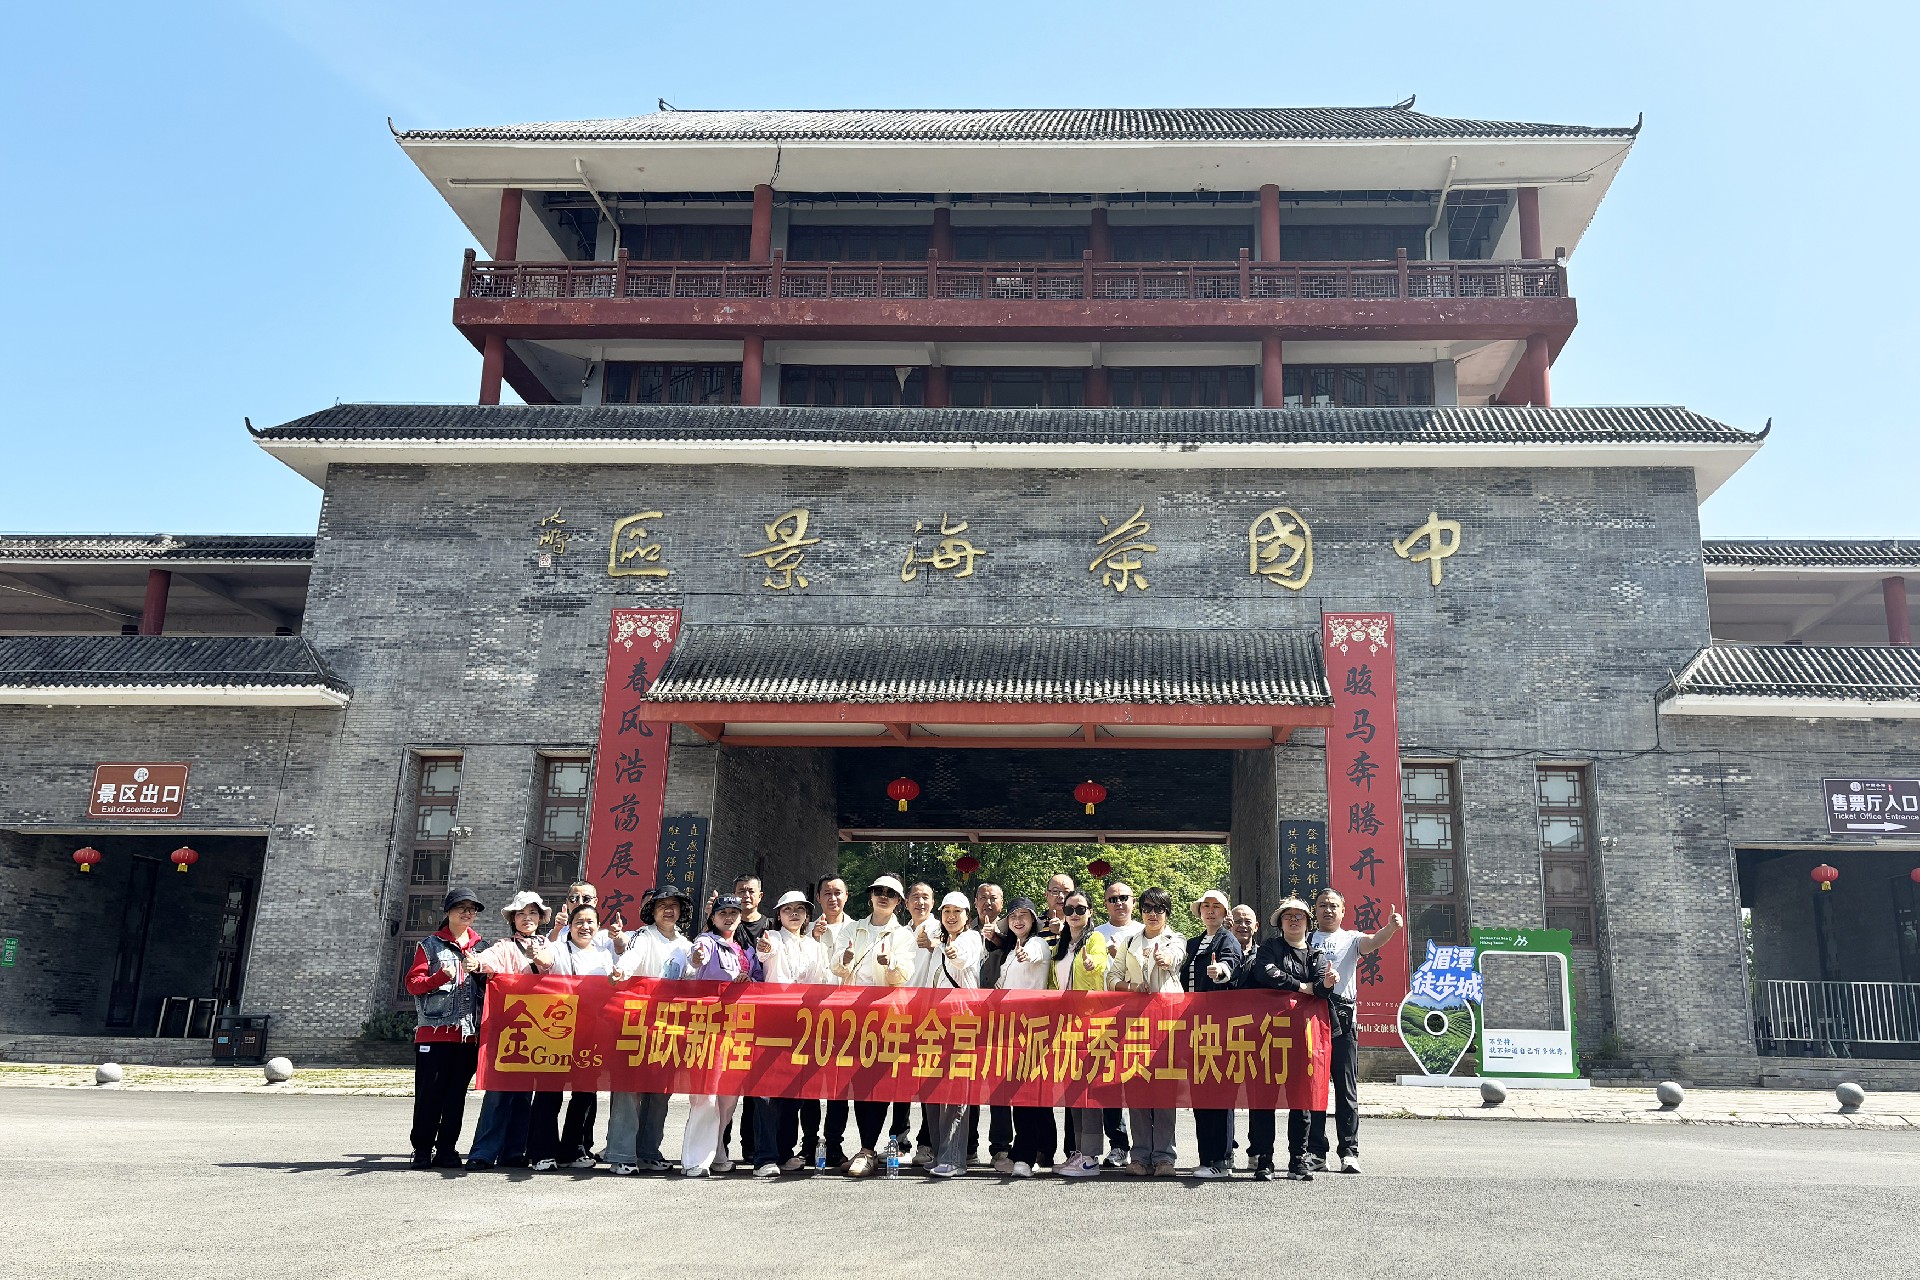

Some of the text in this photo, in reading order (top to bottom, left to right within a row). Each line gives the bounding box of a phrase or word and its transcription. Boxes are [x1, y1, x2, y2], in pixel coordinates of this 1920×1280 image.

[97, 783, 180, 804] 景区出口
[1831, 793, 1918, 812] 售票厅入口
[101, 805, 169, 814] Exit of scenic spot
[1833, 812, 1920, 821] Ticket Office Entrance
[1420, 941, 1476, 973] 湄潭
[1412, 971, 1483, 1004] 徒步城
[530, 1044, 604, 1069] Gong's
